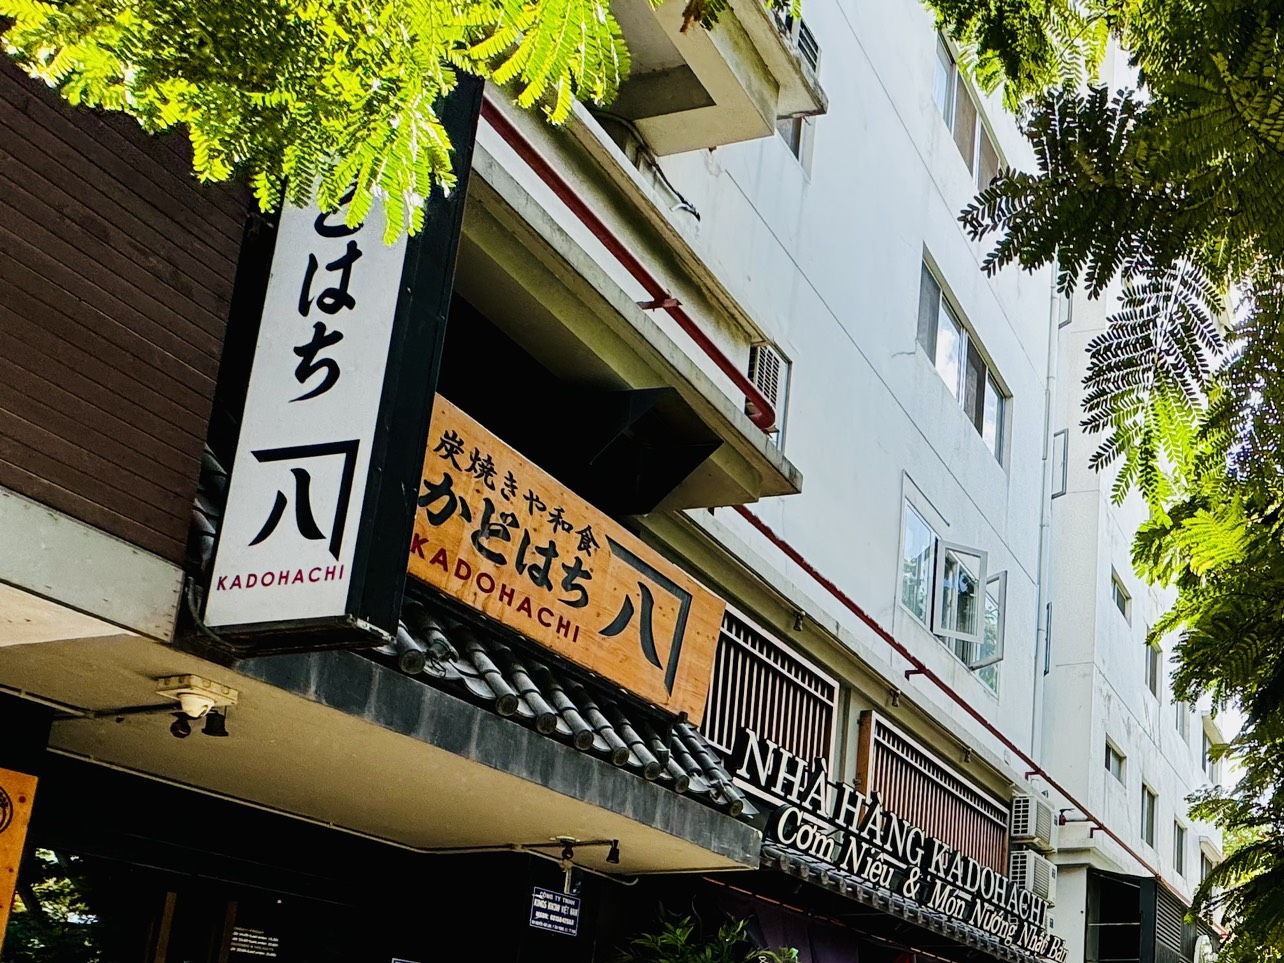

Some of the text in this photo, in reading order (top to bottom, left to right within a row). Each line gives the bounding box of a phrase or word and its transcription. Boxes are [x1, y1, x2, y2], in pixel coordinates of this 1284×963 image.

[417, 471, 593, 608] かどはち
[432, 429, 601, 557] 炭焼きや和食
[216, 564, 346, 591] KADOHACHI
[410, 532, 580, 643] KADOHACHI
[736, 728, 1050, 930] NHÀ HÀNG KADOHACHI
[777, 806, 835, 863] Cơm
[839, 835, 894, 889] Niêu
[902, 866, 921, 900] &
[927, 879, 967, 919] Món
[969, 899, 1019, 946] Nướng
